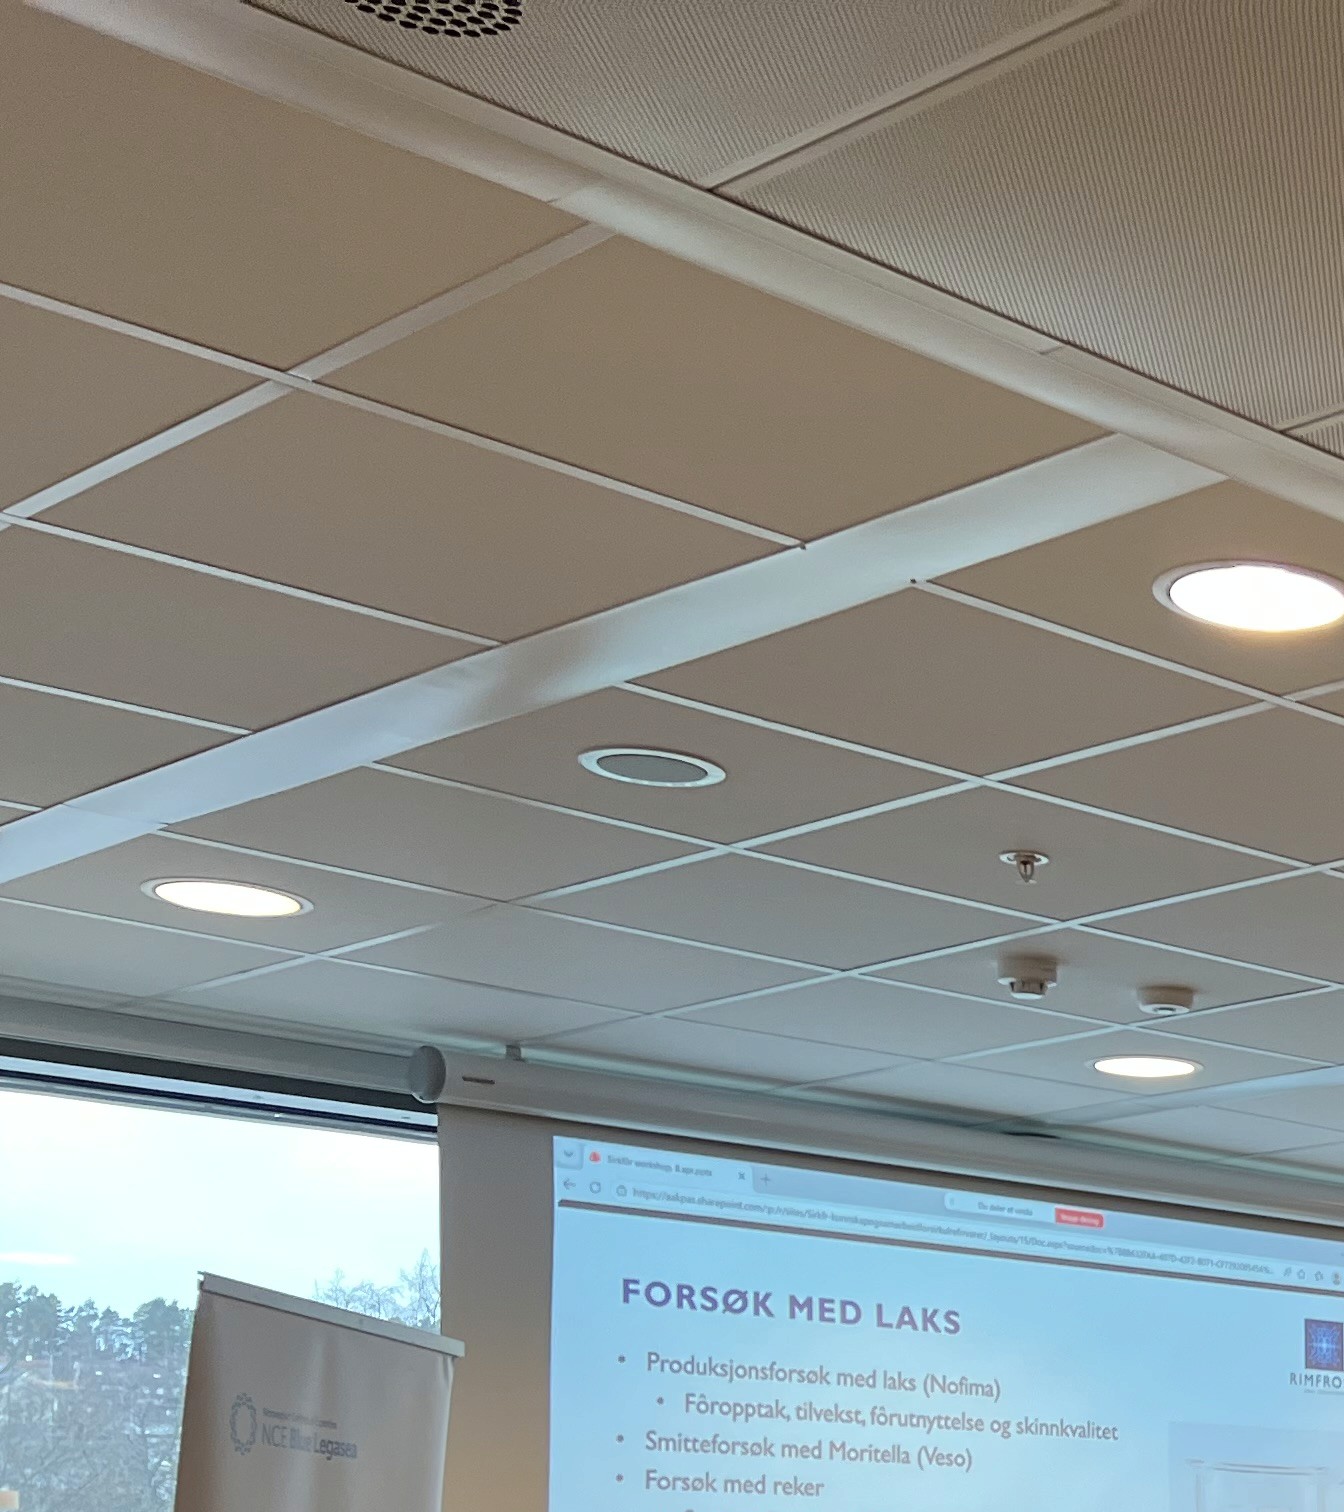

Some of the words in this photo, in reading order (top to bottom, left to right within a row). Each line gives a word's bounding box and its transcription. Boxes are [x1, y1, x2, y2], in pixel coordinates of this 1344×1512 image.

[622, 1278, 775, 1318] FORSØK
[789, 1294, 862, 1325] MED
[876, 1303, 961, 1335] LAKS
[647, 1351, 831, 1386] Produksjonsforsøk
[837, 1367, 876, 1389] med
[883, 1370, 917, 1392] laks
[923, 1373, 1001, 1403] (Nofima)
[685, 1393, 790, 1423] Fôropptak,
[795, 1401, 866, 1427] tilvekst,
[870, 1406, 984, 1435] fôrutnyttelse
[990, 1419, 1011, 1439] og
[1016, 1416, 1119, 1441] skinnkvalitet
[262, 1422, 288, 1449] NCE
[314, 1432, 357, 1461] Legasea
[645, 1430, 775, 1458] Smitteforsøk
[781, 1440, 822, 1460] med
[829, 1440, 911, 1465] Moritella
[917, 1445, 973, 1473] (Veso)
[645, 1469, 717, 1493] Forsøk
[723, 1474, 766, 1495] med
[773, 1476, 824, 1497] reker
